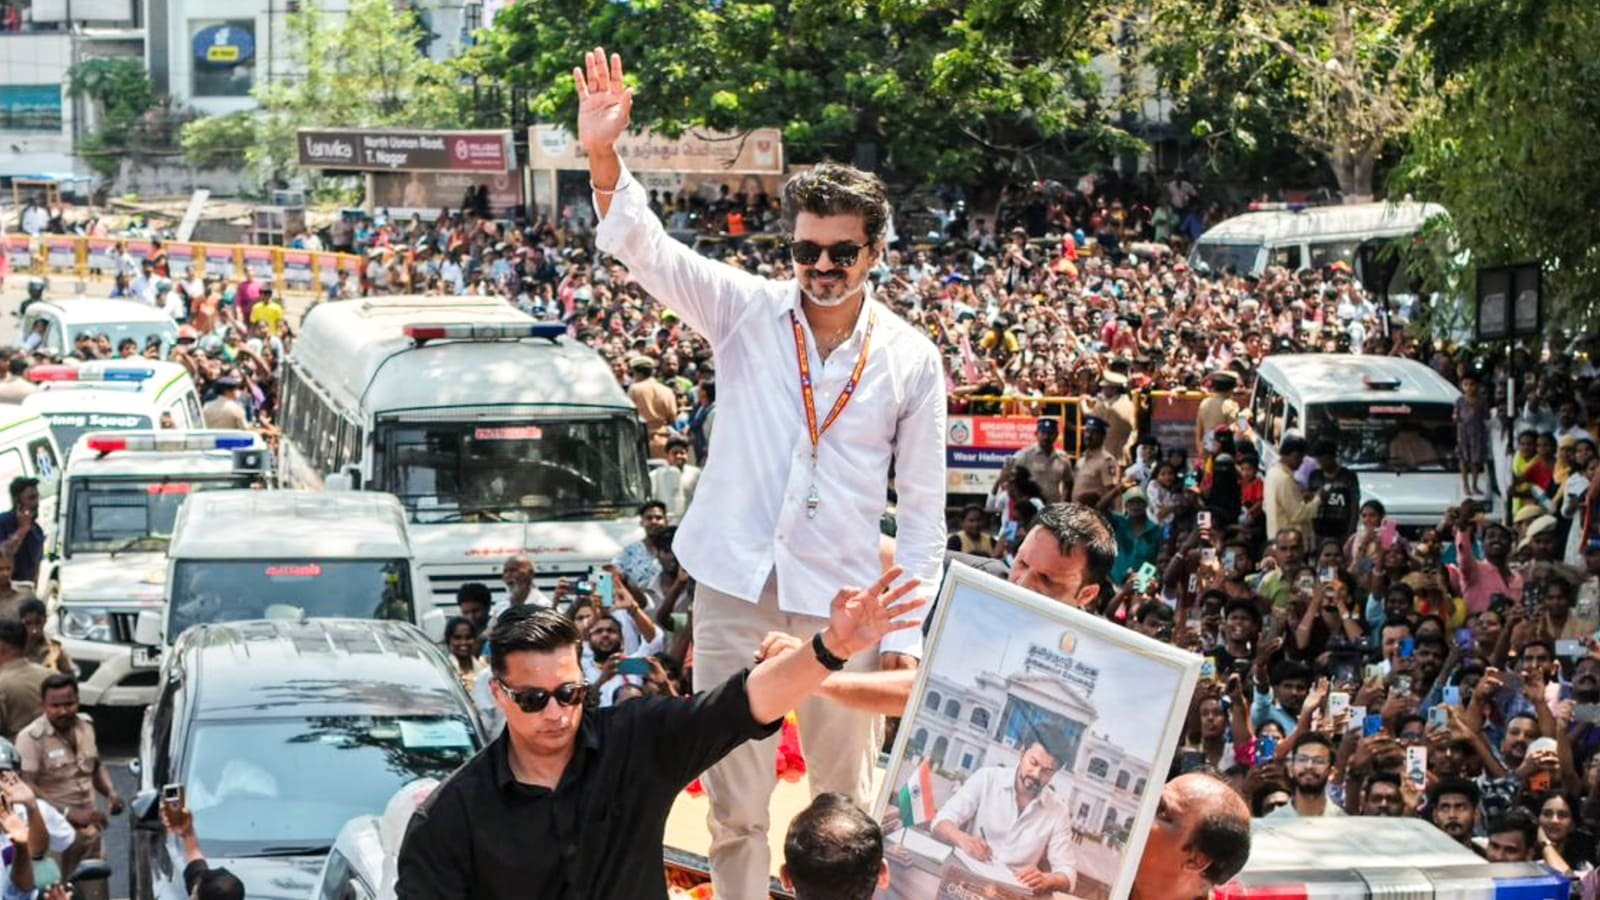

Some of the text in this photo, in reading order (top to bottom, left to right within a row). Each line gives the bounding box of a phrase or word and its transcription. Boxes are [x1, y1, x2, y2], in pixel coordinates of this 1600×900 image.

[364, 136, 388, 150] North
[364, 150, 408, 168] T. Nagar
[953, 452, 977, 461] Wear
